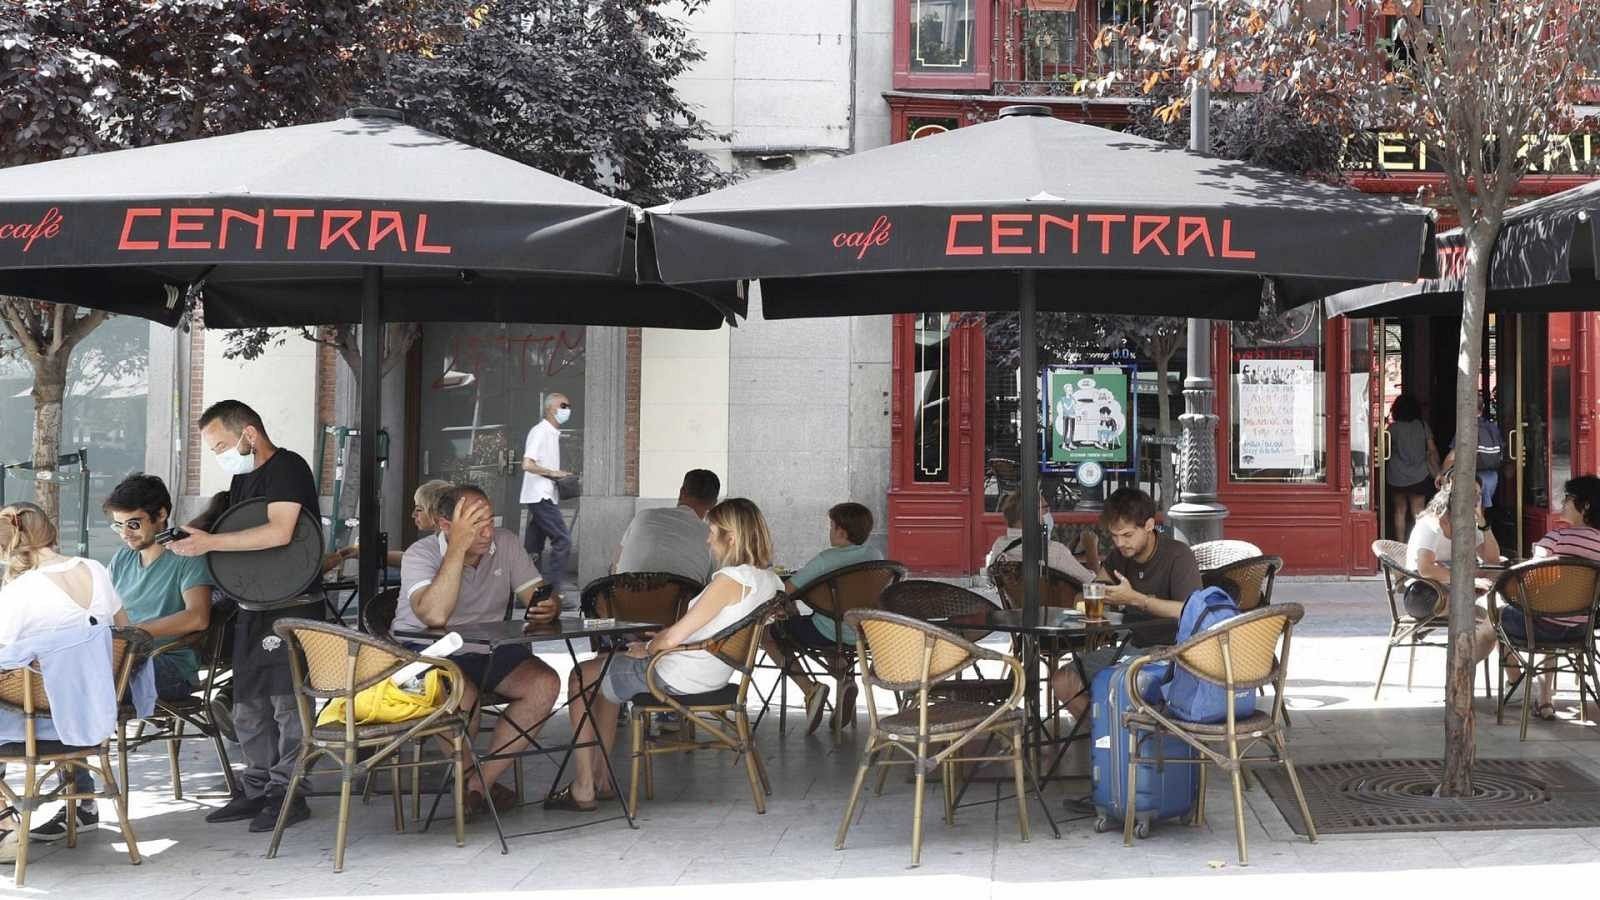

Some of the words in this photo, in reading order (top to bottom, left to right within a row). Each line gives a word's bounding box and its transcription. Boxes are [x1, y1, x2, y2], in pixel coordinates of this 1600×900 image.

[0, 207, 64, 252] café
[118, 207, 451, 254] CENTRAL
[832, 216, 892, 258] café
[945, 213, 1256, 260] CENTRAL
